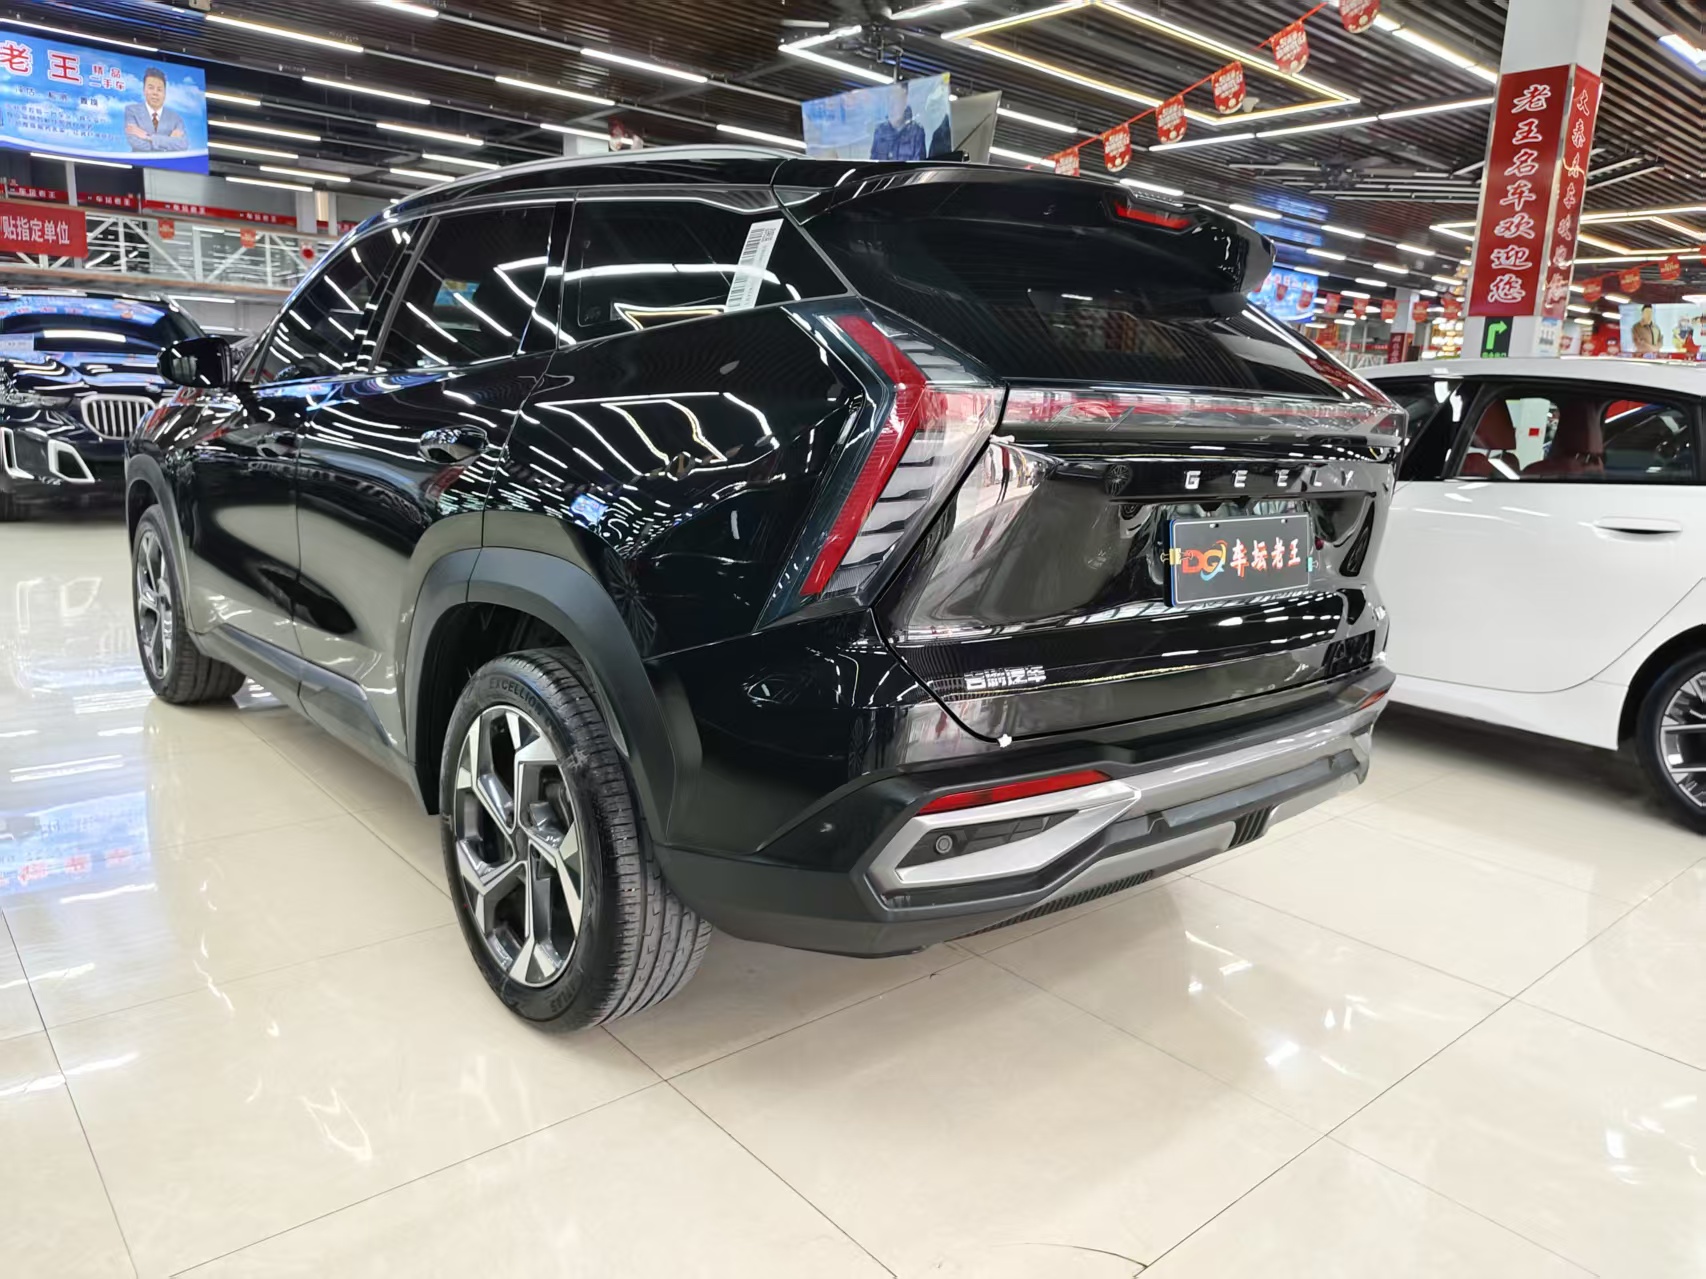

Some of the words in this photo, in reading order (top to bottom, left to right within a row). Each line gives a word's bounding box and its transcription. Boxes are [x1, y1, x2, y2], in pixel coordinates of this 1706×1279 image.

[0, 40, 83, 86] 老王
[89, 75, 125, 91] 二手车
[1488, 84, 1551, 303] 老王名车欢迎您
[0, 215, 70, 244] 贴指定单位
[1184, 469, 1354, 490] GEELY
[1230, 536, 1301, 578] 车坛老王
